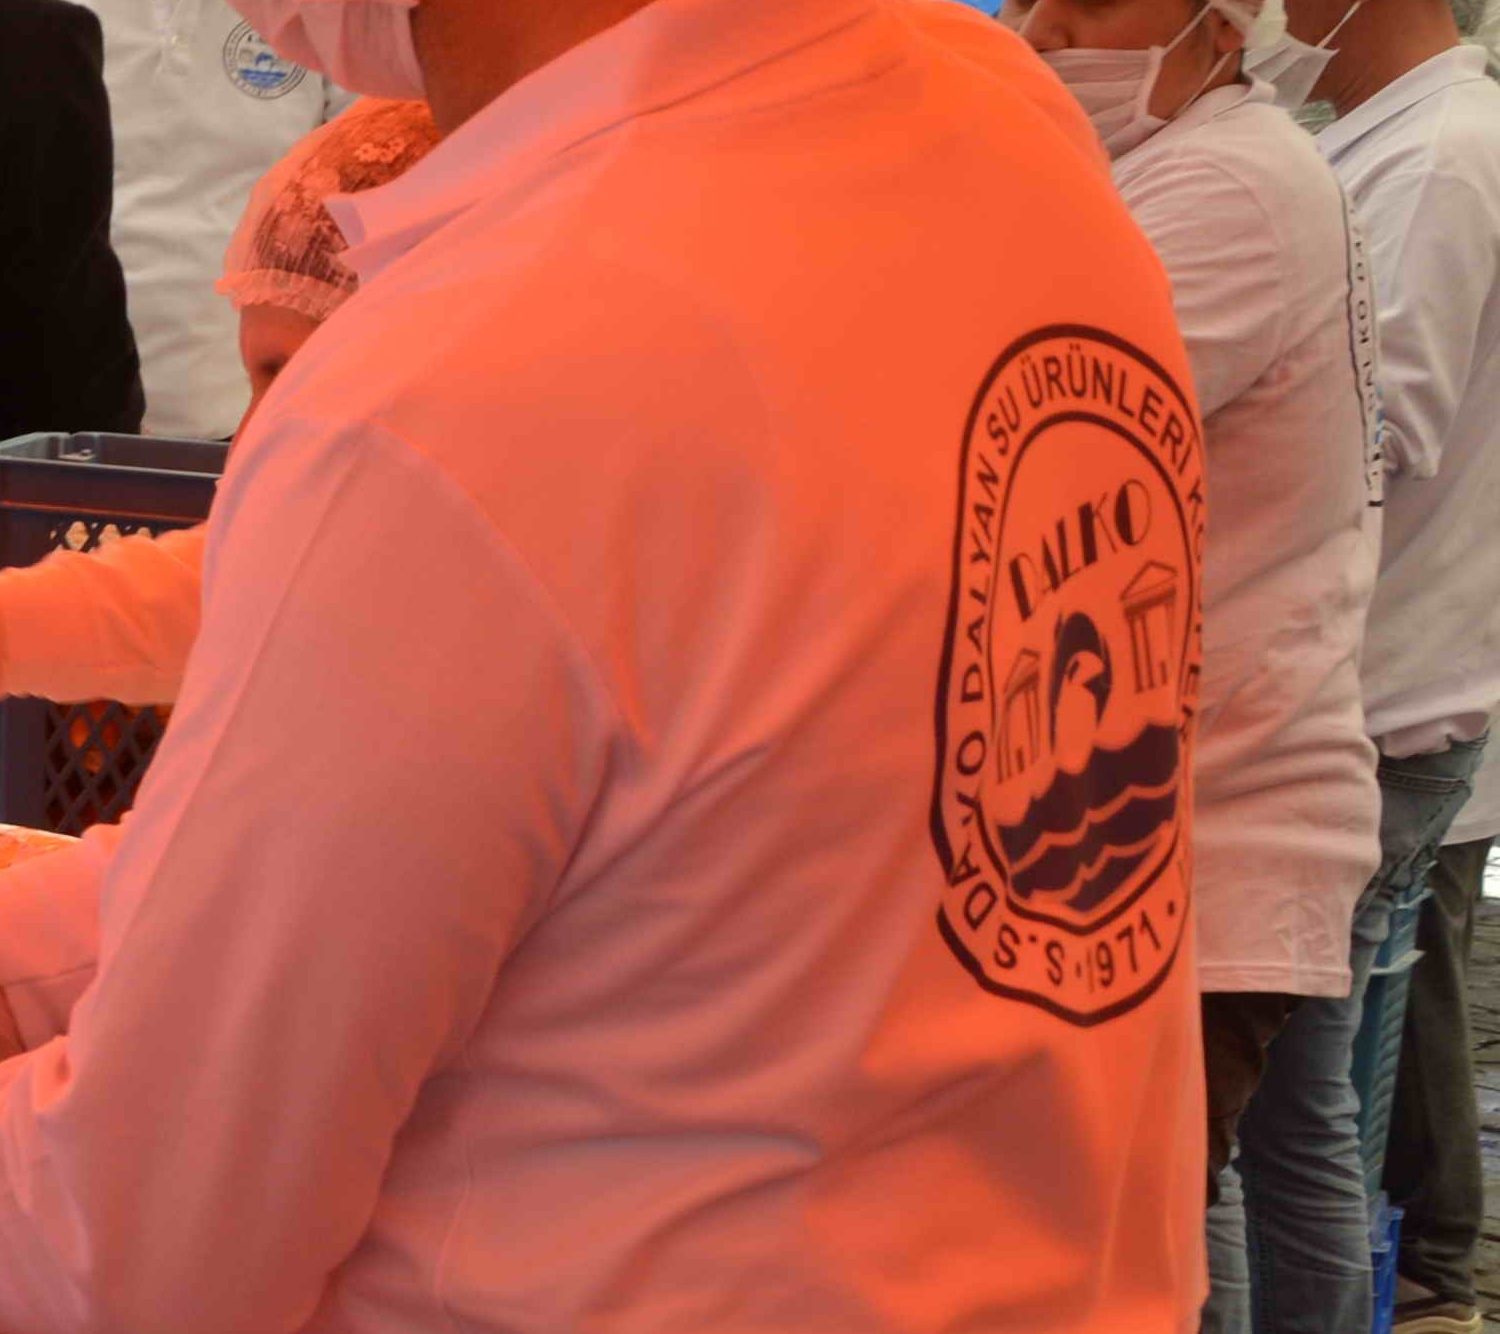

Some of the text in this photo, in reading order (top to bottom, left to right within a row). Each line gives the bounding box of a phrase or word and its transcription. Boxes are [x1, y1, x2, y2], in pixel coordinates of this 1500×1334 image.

[961, 451, 1000, 704] DALYAN
[986, 384, 1022, 456] SU
[1009, 478, 1151, 622] DALKO
[1088, 909, 1163, 993] 1971
